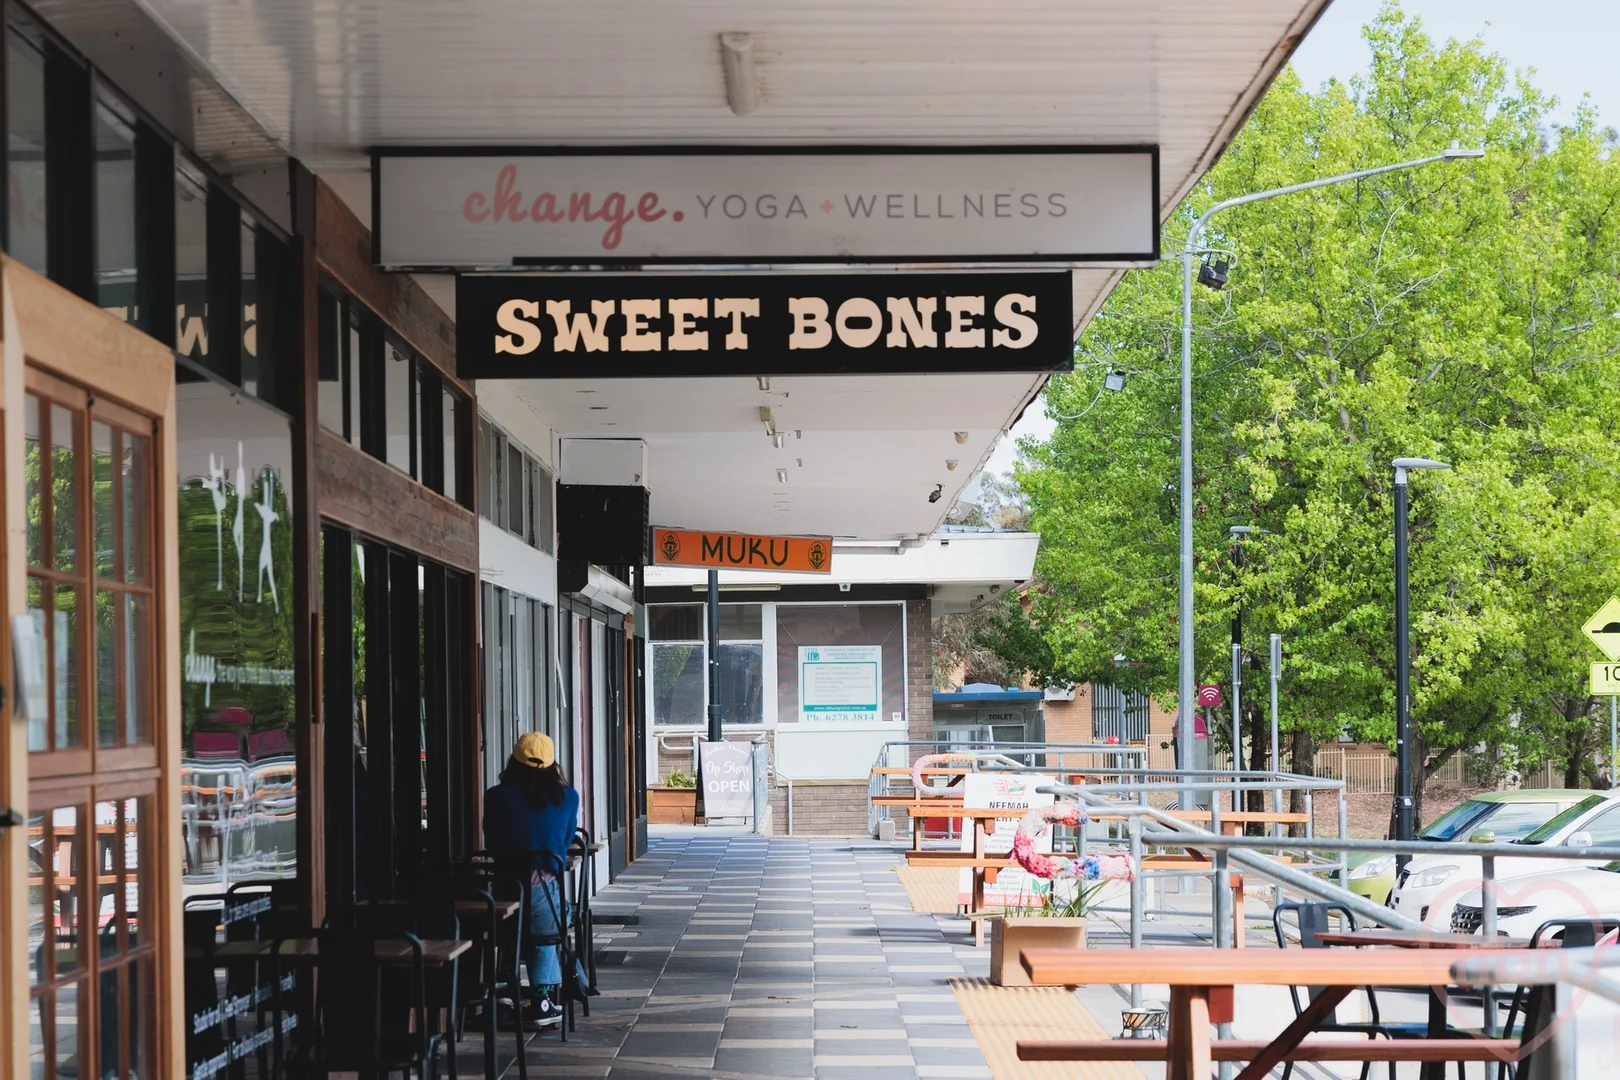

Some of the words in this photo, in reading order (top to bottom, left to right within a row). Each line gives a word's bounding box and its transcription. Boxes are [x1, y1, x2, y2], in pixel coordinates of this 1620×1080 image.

[464, 164, 684, 250] change.
[697, 195, 807, 219] YOGA
[843, 193, 1067, 219] WELLNESS
[494, 297, 760, 355] SWEET
[788, 292, 1039, 350] BONES
[702, 534, 789, 566] MUKU
[825, 713, 848, 721] 6278
[705, 760, 721, 776] Op
[723, 760, 749, 776] Shop
[708, 780, 750, 793] OPEN
